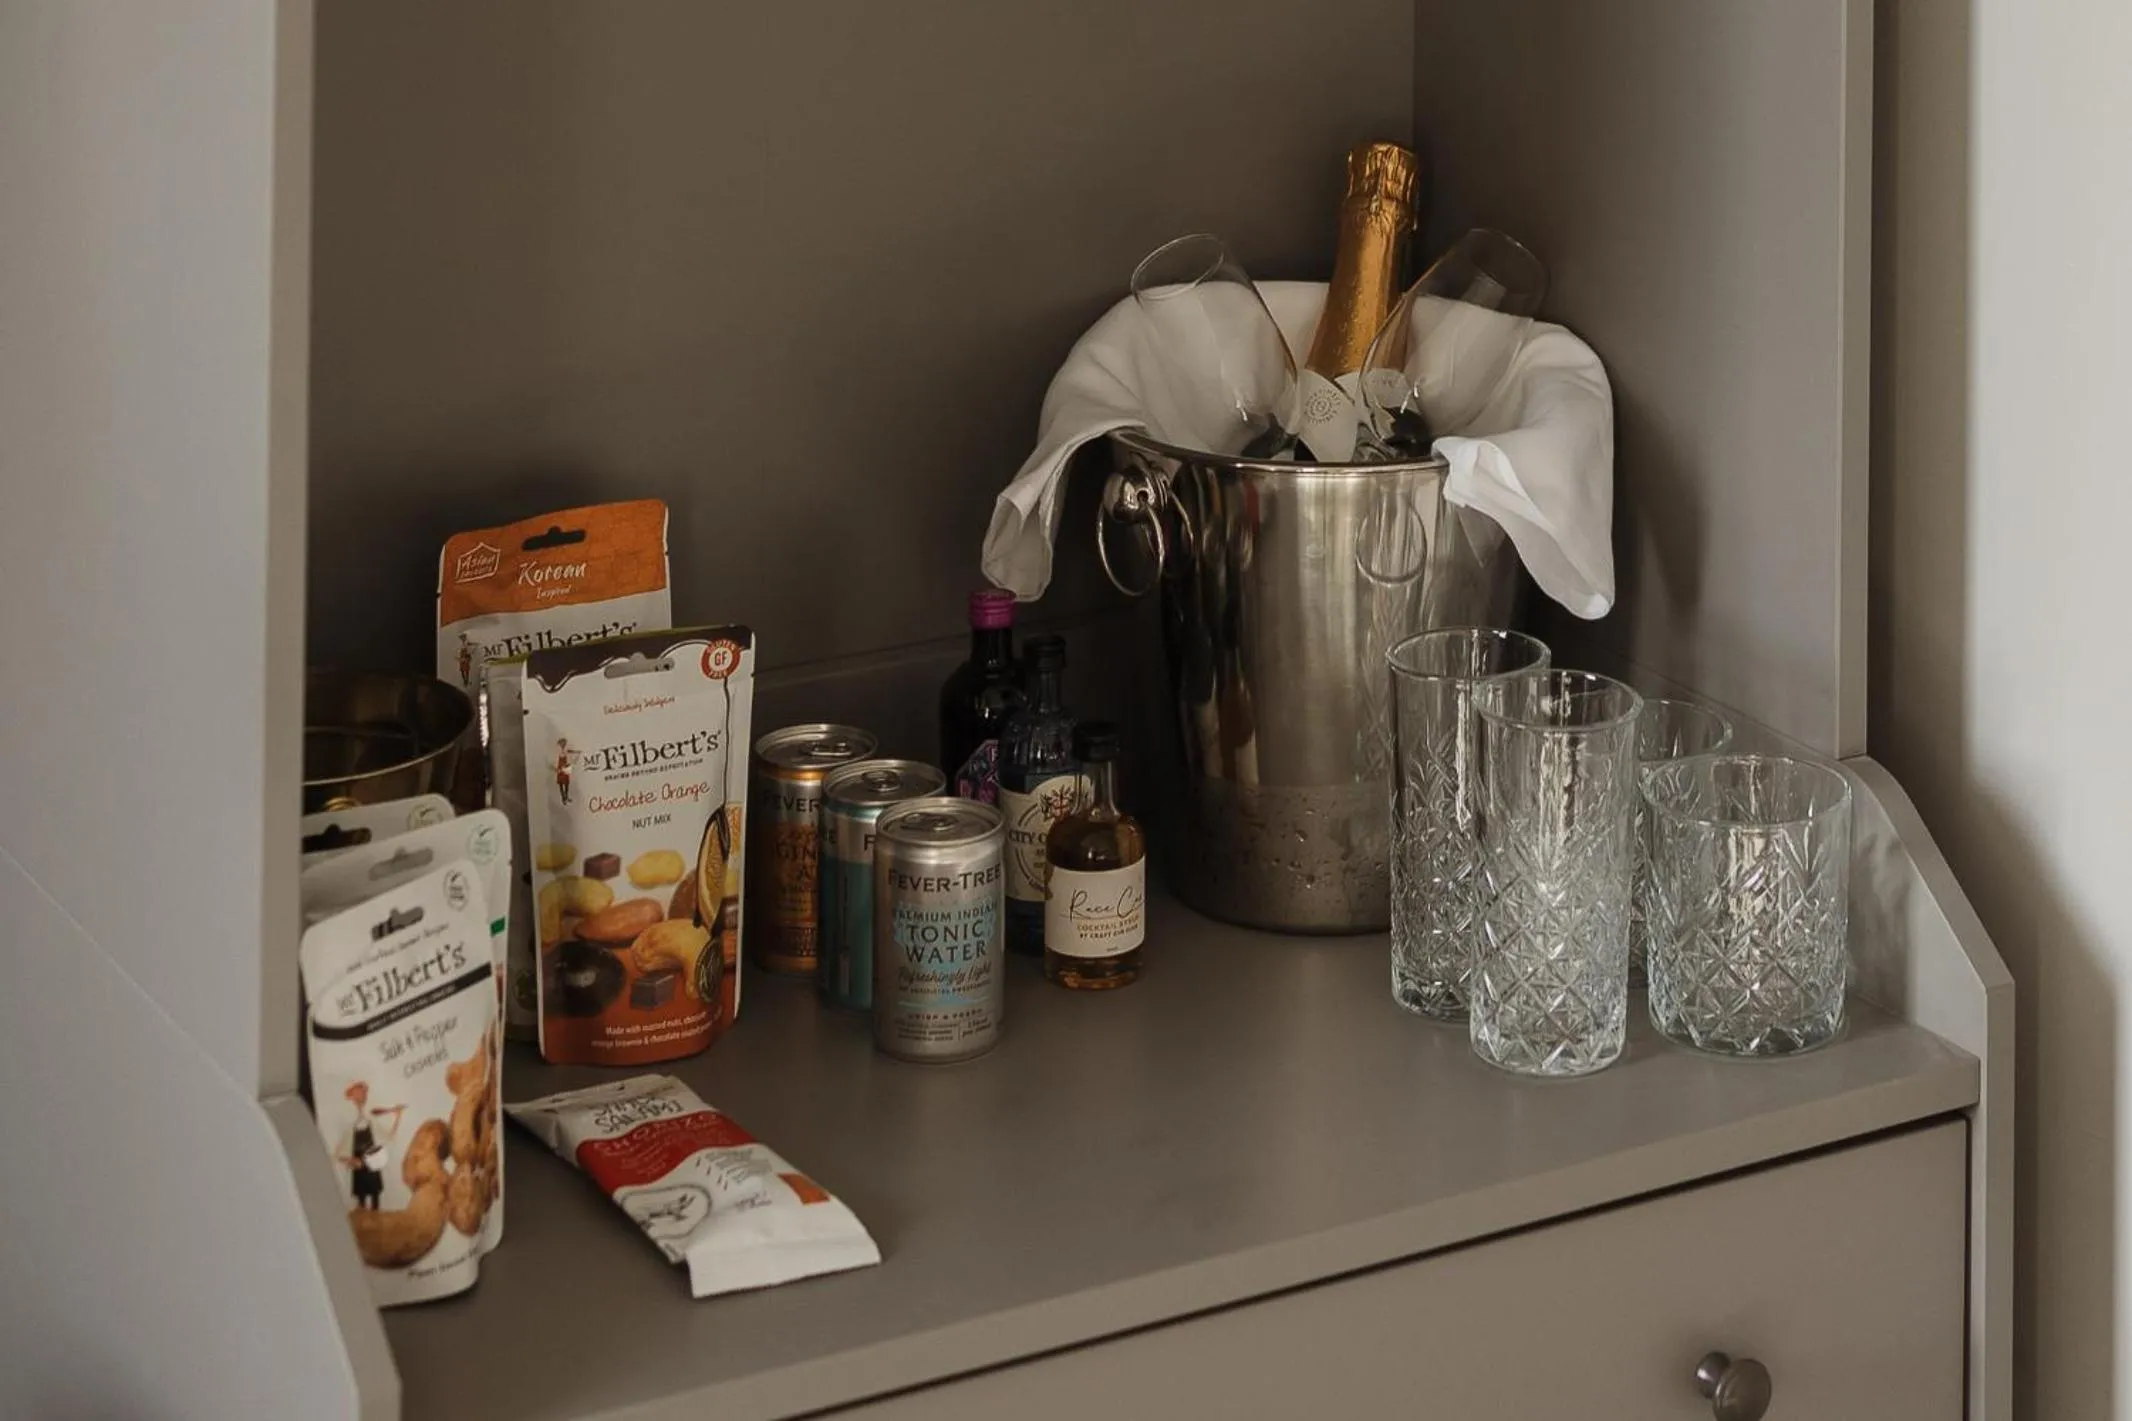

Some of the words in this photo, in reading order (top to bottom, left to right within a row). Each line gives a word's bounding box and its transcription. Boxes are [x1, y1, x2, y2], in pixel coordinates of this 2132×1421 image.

[519, 560, 587, 587] Korean
[714, 650, 728, 666] GF
[602, 730, 719, 771] Filbert's
[588, 789, 658, 813] Chocolate
[661, 782, 710, 802] Orange
[631, 817, 652, 830] NUT
[653, 814, 672, 825] MIX
[887, 863, 1001, 893] FEVER-TREE
[905, 919, 984, 943] TONIC
[906, 940, 986, 964] WATER
[353, 942, 467, 1012] Filbert's
